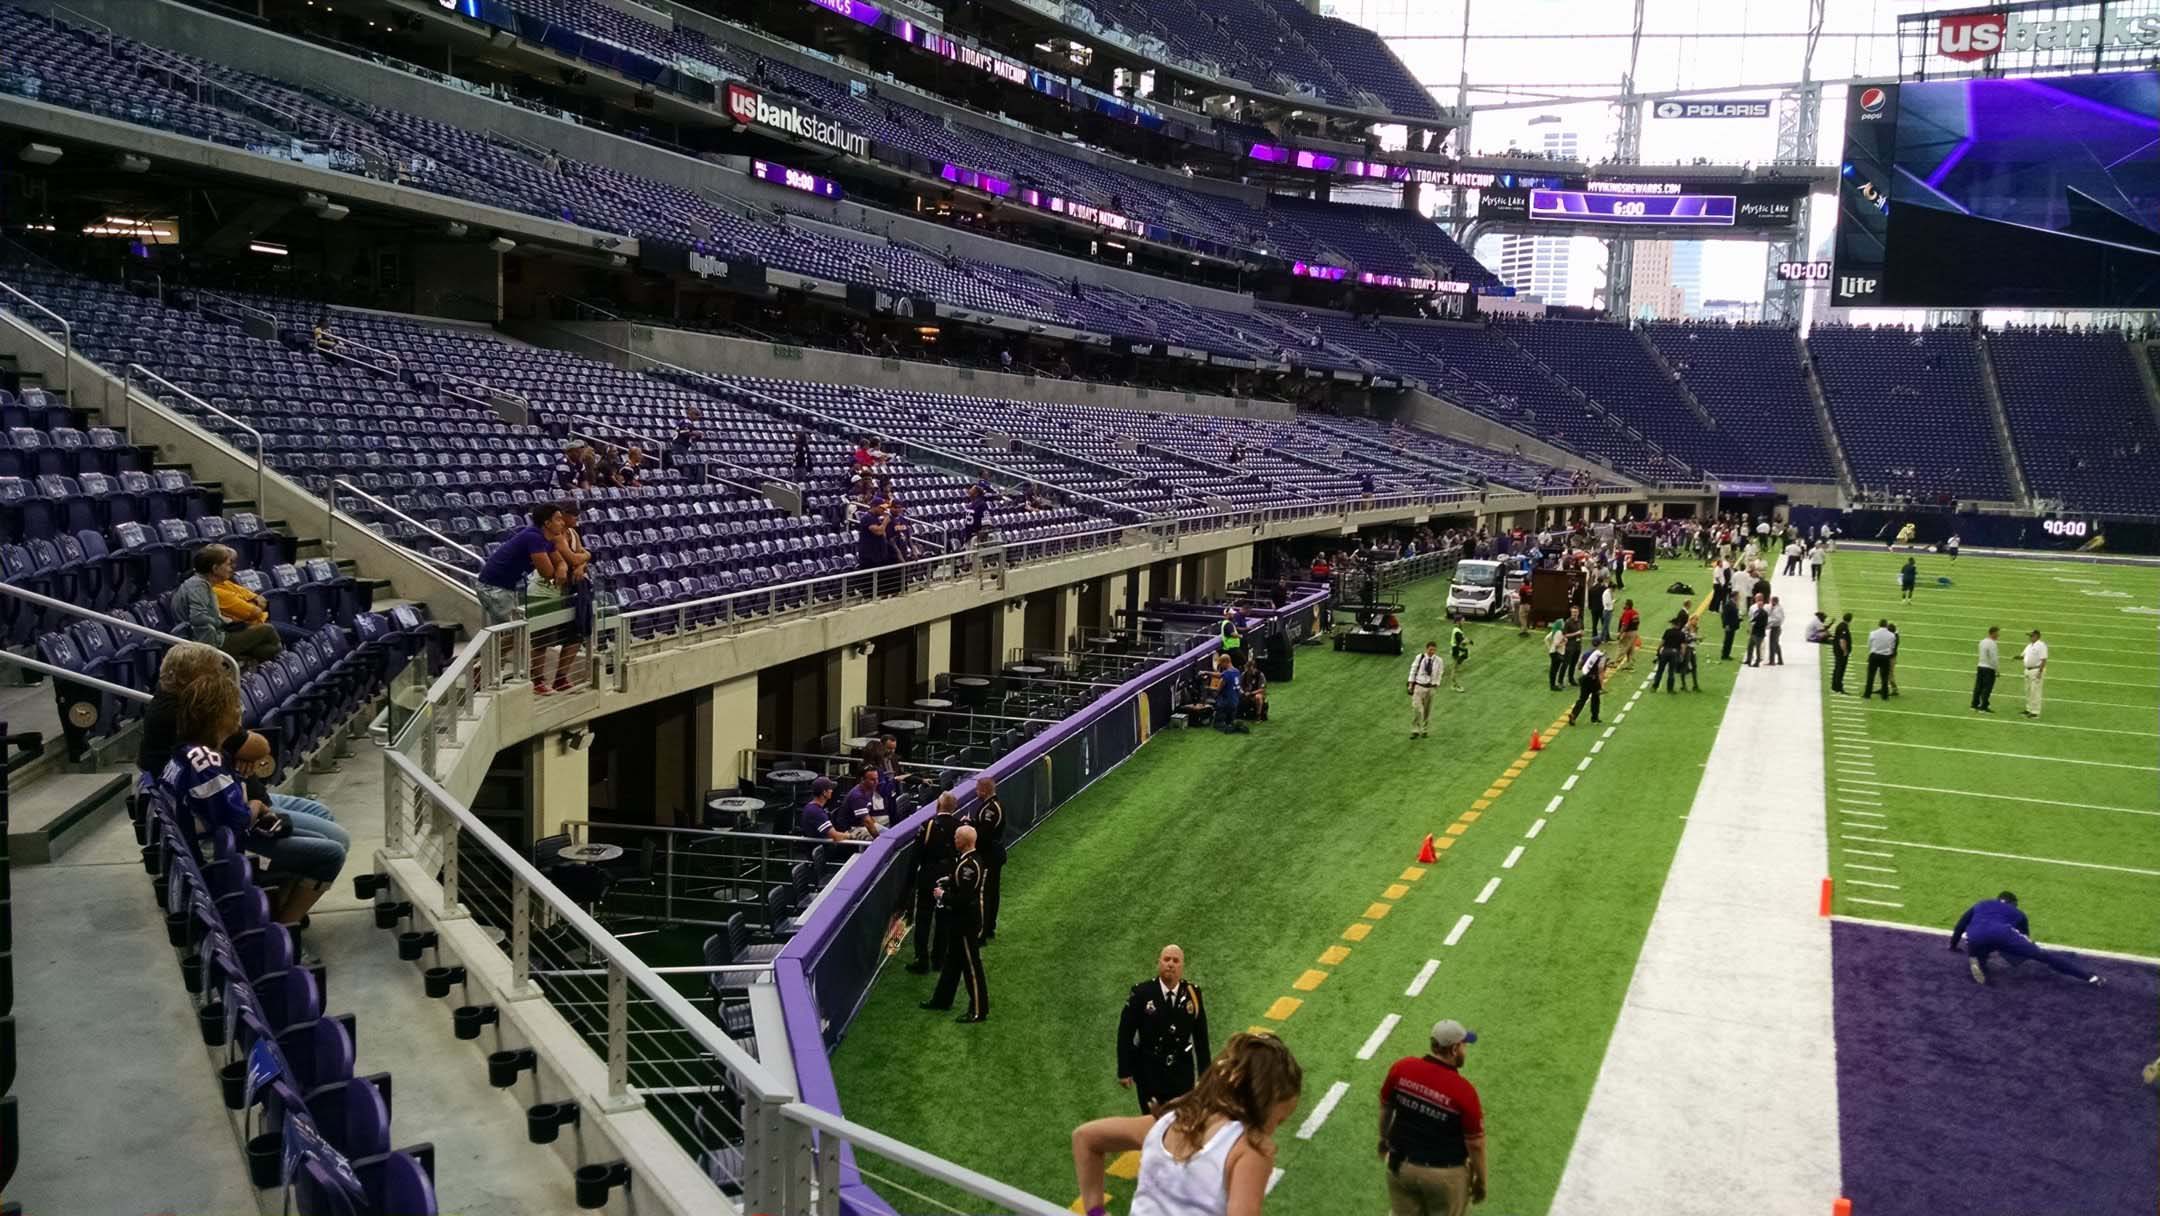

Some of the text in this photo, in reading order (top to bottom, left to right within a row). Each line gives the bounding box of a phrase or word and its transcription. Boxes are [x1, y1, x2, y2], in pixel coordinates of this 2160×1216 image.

[961, 46, 1027, 86] TODAY'S MATCHUP
[1686, 104, 1767, 117] POLARIS
[1861, 111, 1882, 121] pepsi
[786, 169, 814, 191] 90:00
[1416, 169, 1494, 188] TODAY'S MATCHUP
[1587, 181, 1681, 194] MYVIKINGSREWARDS.COM
[1779, 263, 1829, 280] 90:00
[1410, 278, 1436, 291] TODAY'S
[1839, 275, 1877, 297] Lite
[2043, 519, 2087, 536] 90:00
